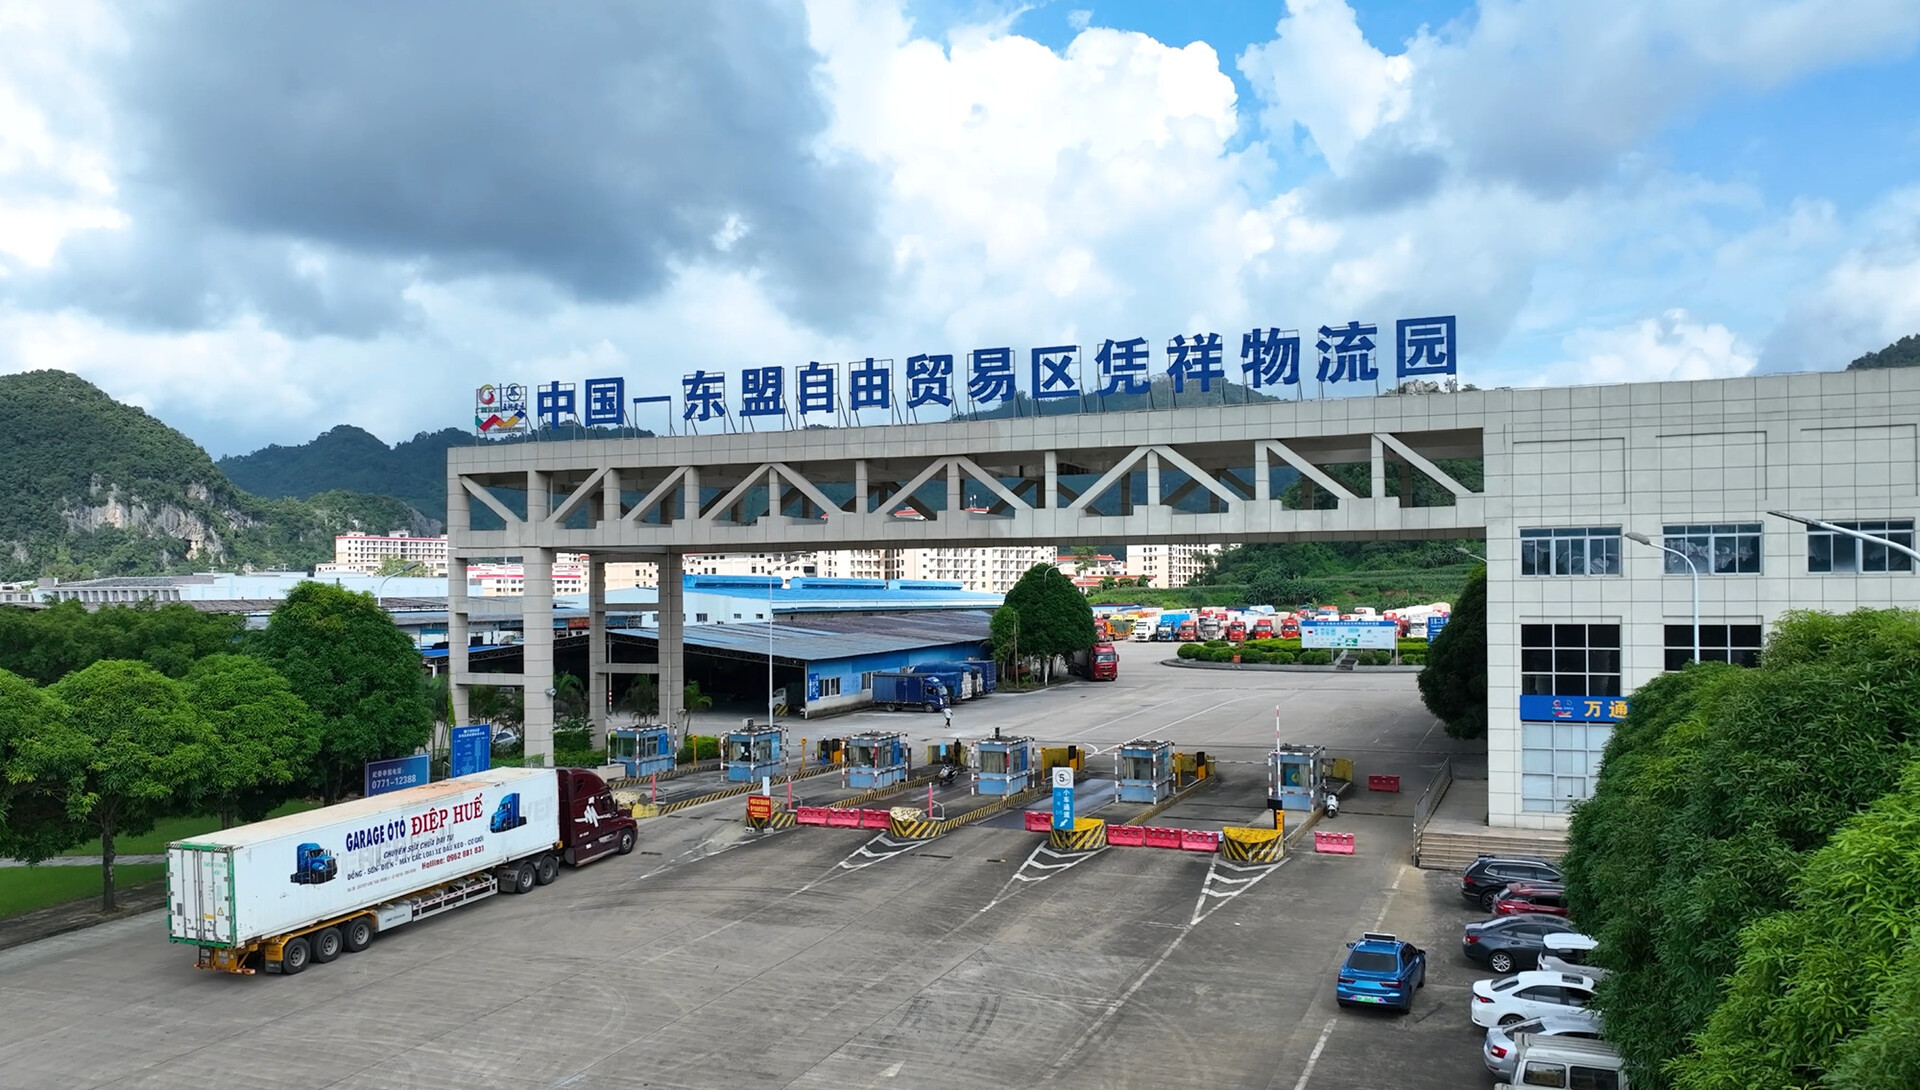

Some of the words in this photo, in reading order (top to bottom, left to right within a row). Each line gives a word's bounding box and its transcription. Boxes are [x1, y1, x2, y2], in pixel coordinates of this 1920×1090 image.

[1584, 701, 1627, 718] 万通
[371, 774, 416, 789] 0771-12388
[346, 825, 384, 852] GARAGE
[411, 807, 448, 836] ĐIỆP
[453, 793, 483, 824] HUẾ
